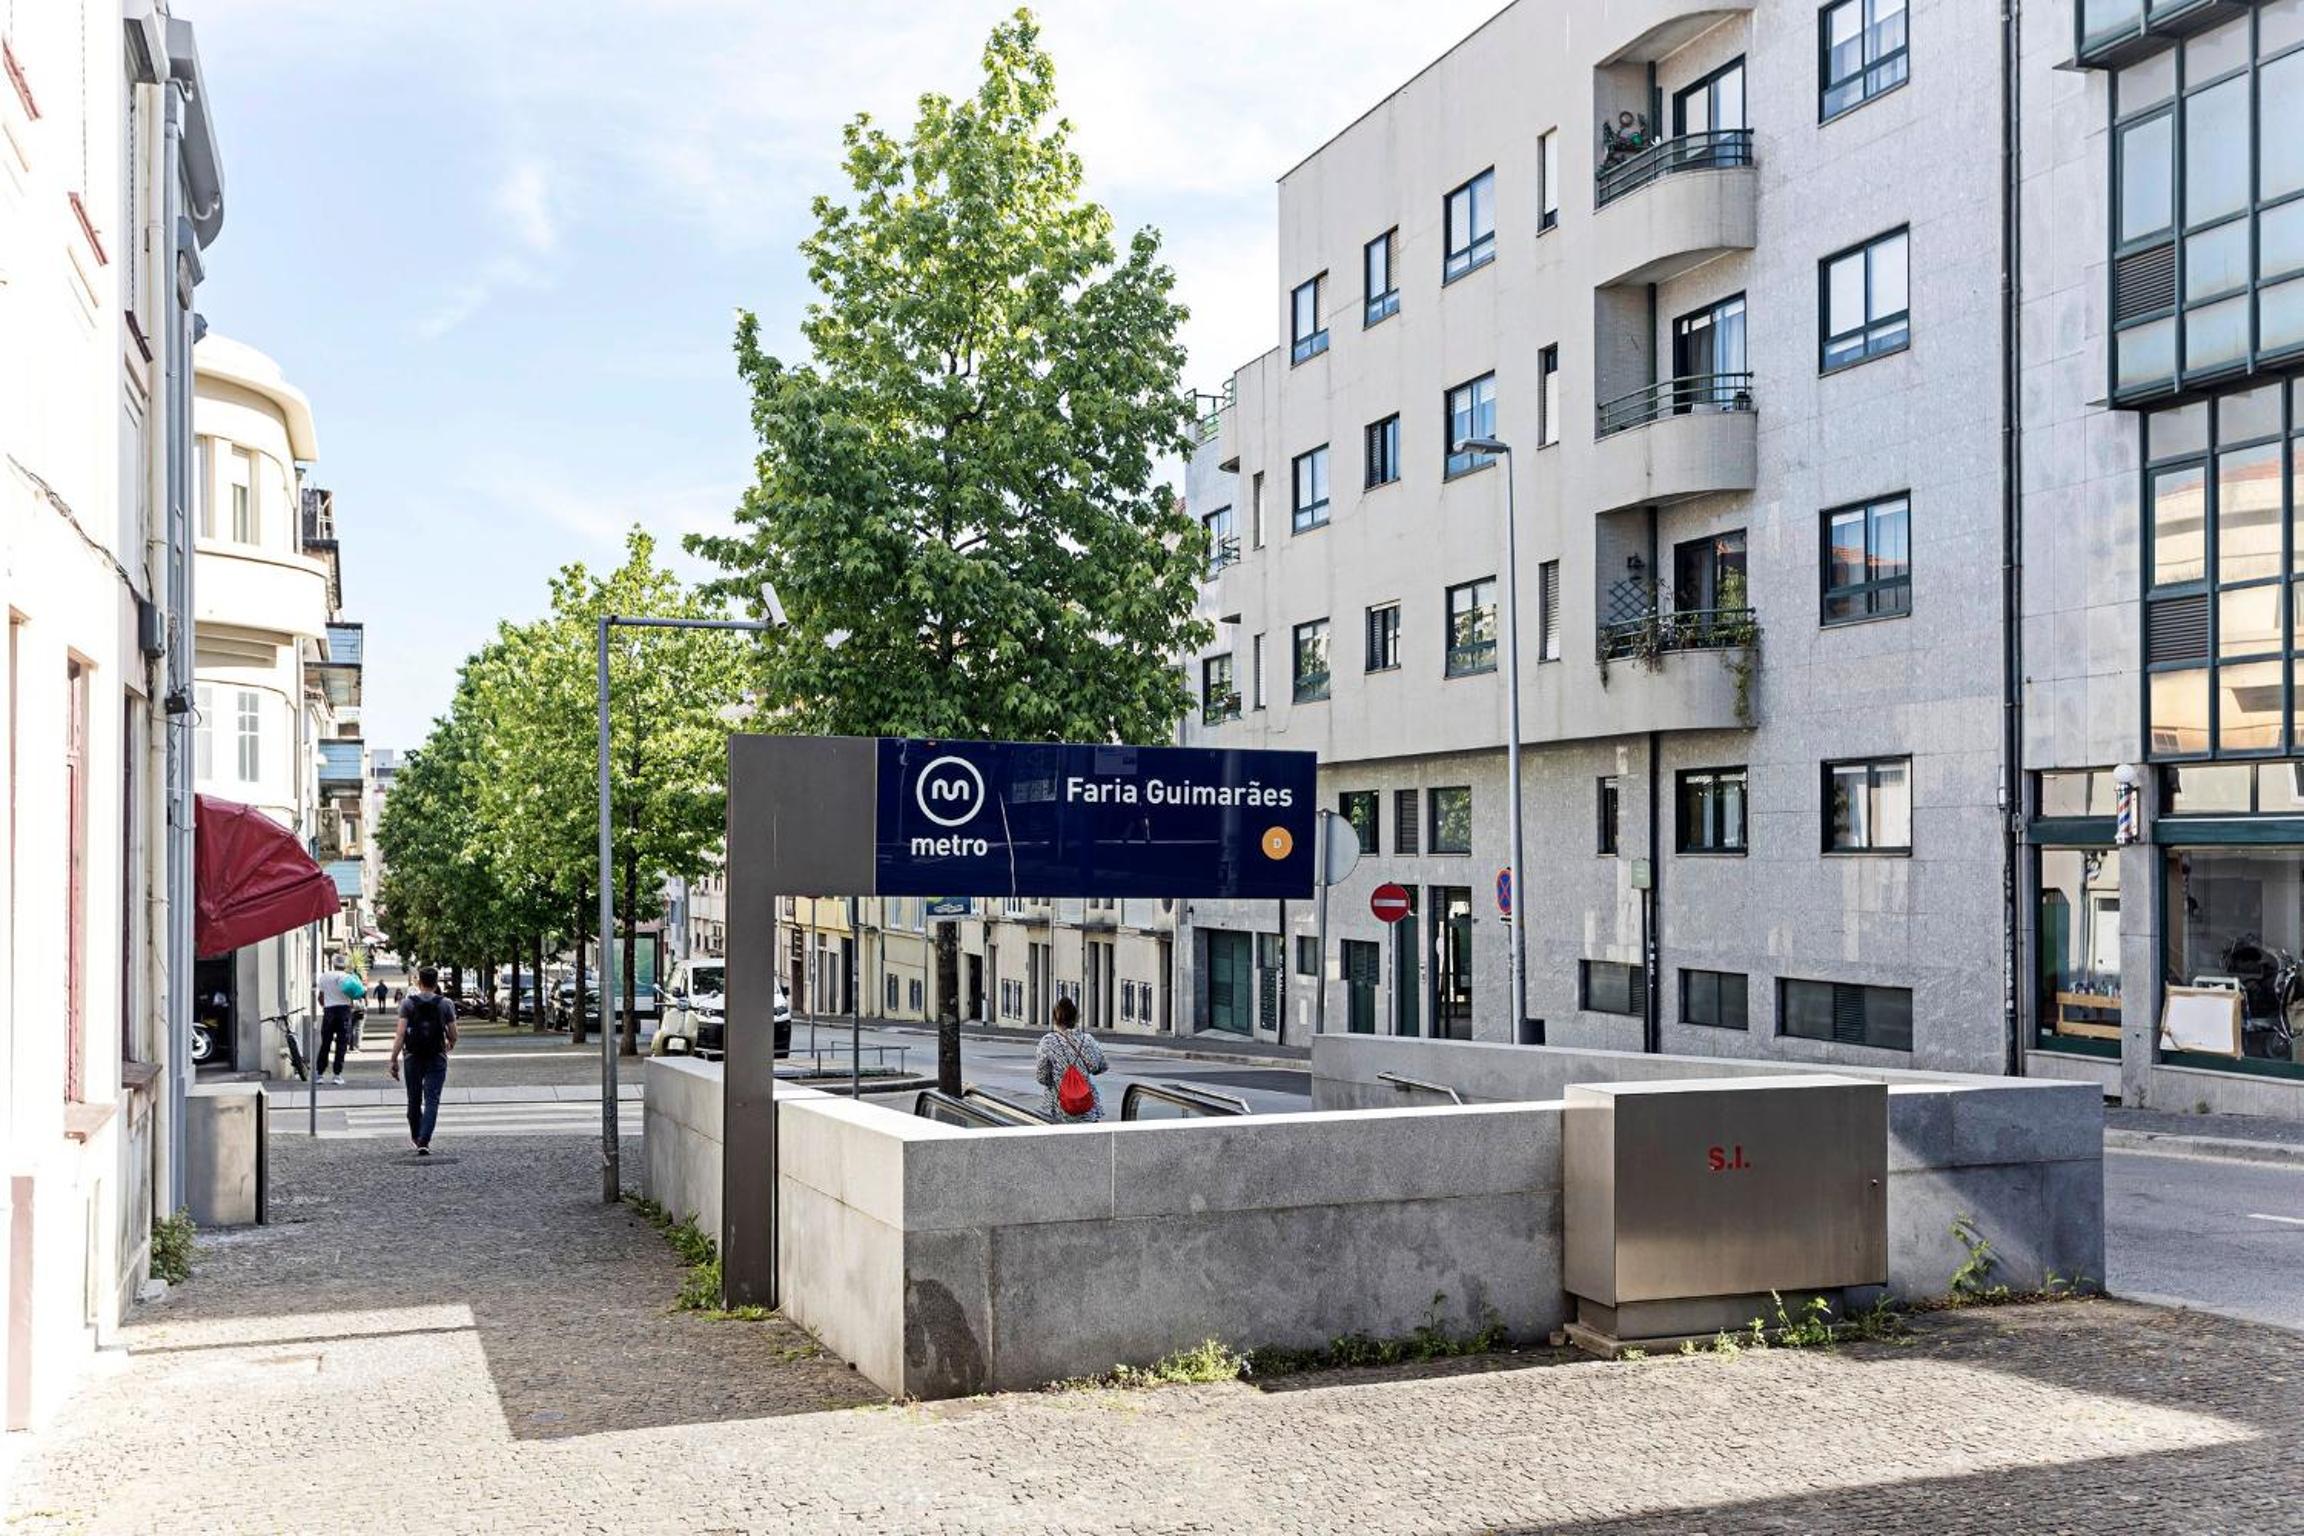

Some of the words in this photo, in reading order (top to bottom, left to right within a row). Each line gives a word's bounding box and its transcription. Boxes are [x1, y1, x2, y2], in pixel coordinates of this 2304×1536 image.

[1066, 776, 1138, 804] Faria
[1146, 779, 1293, 807] Guimarães
[911, 834, 988, 857] metro
